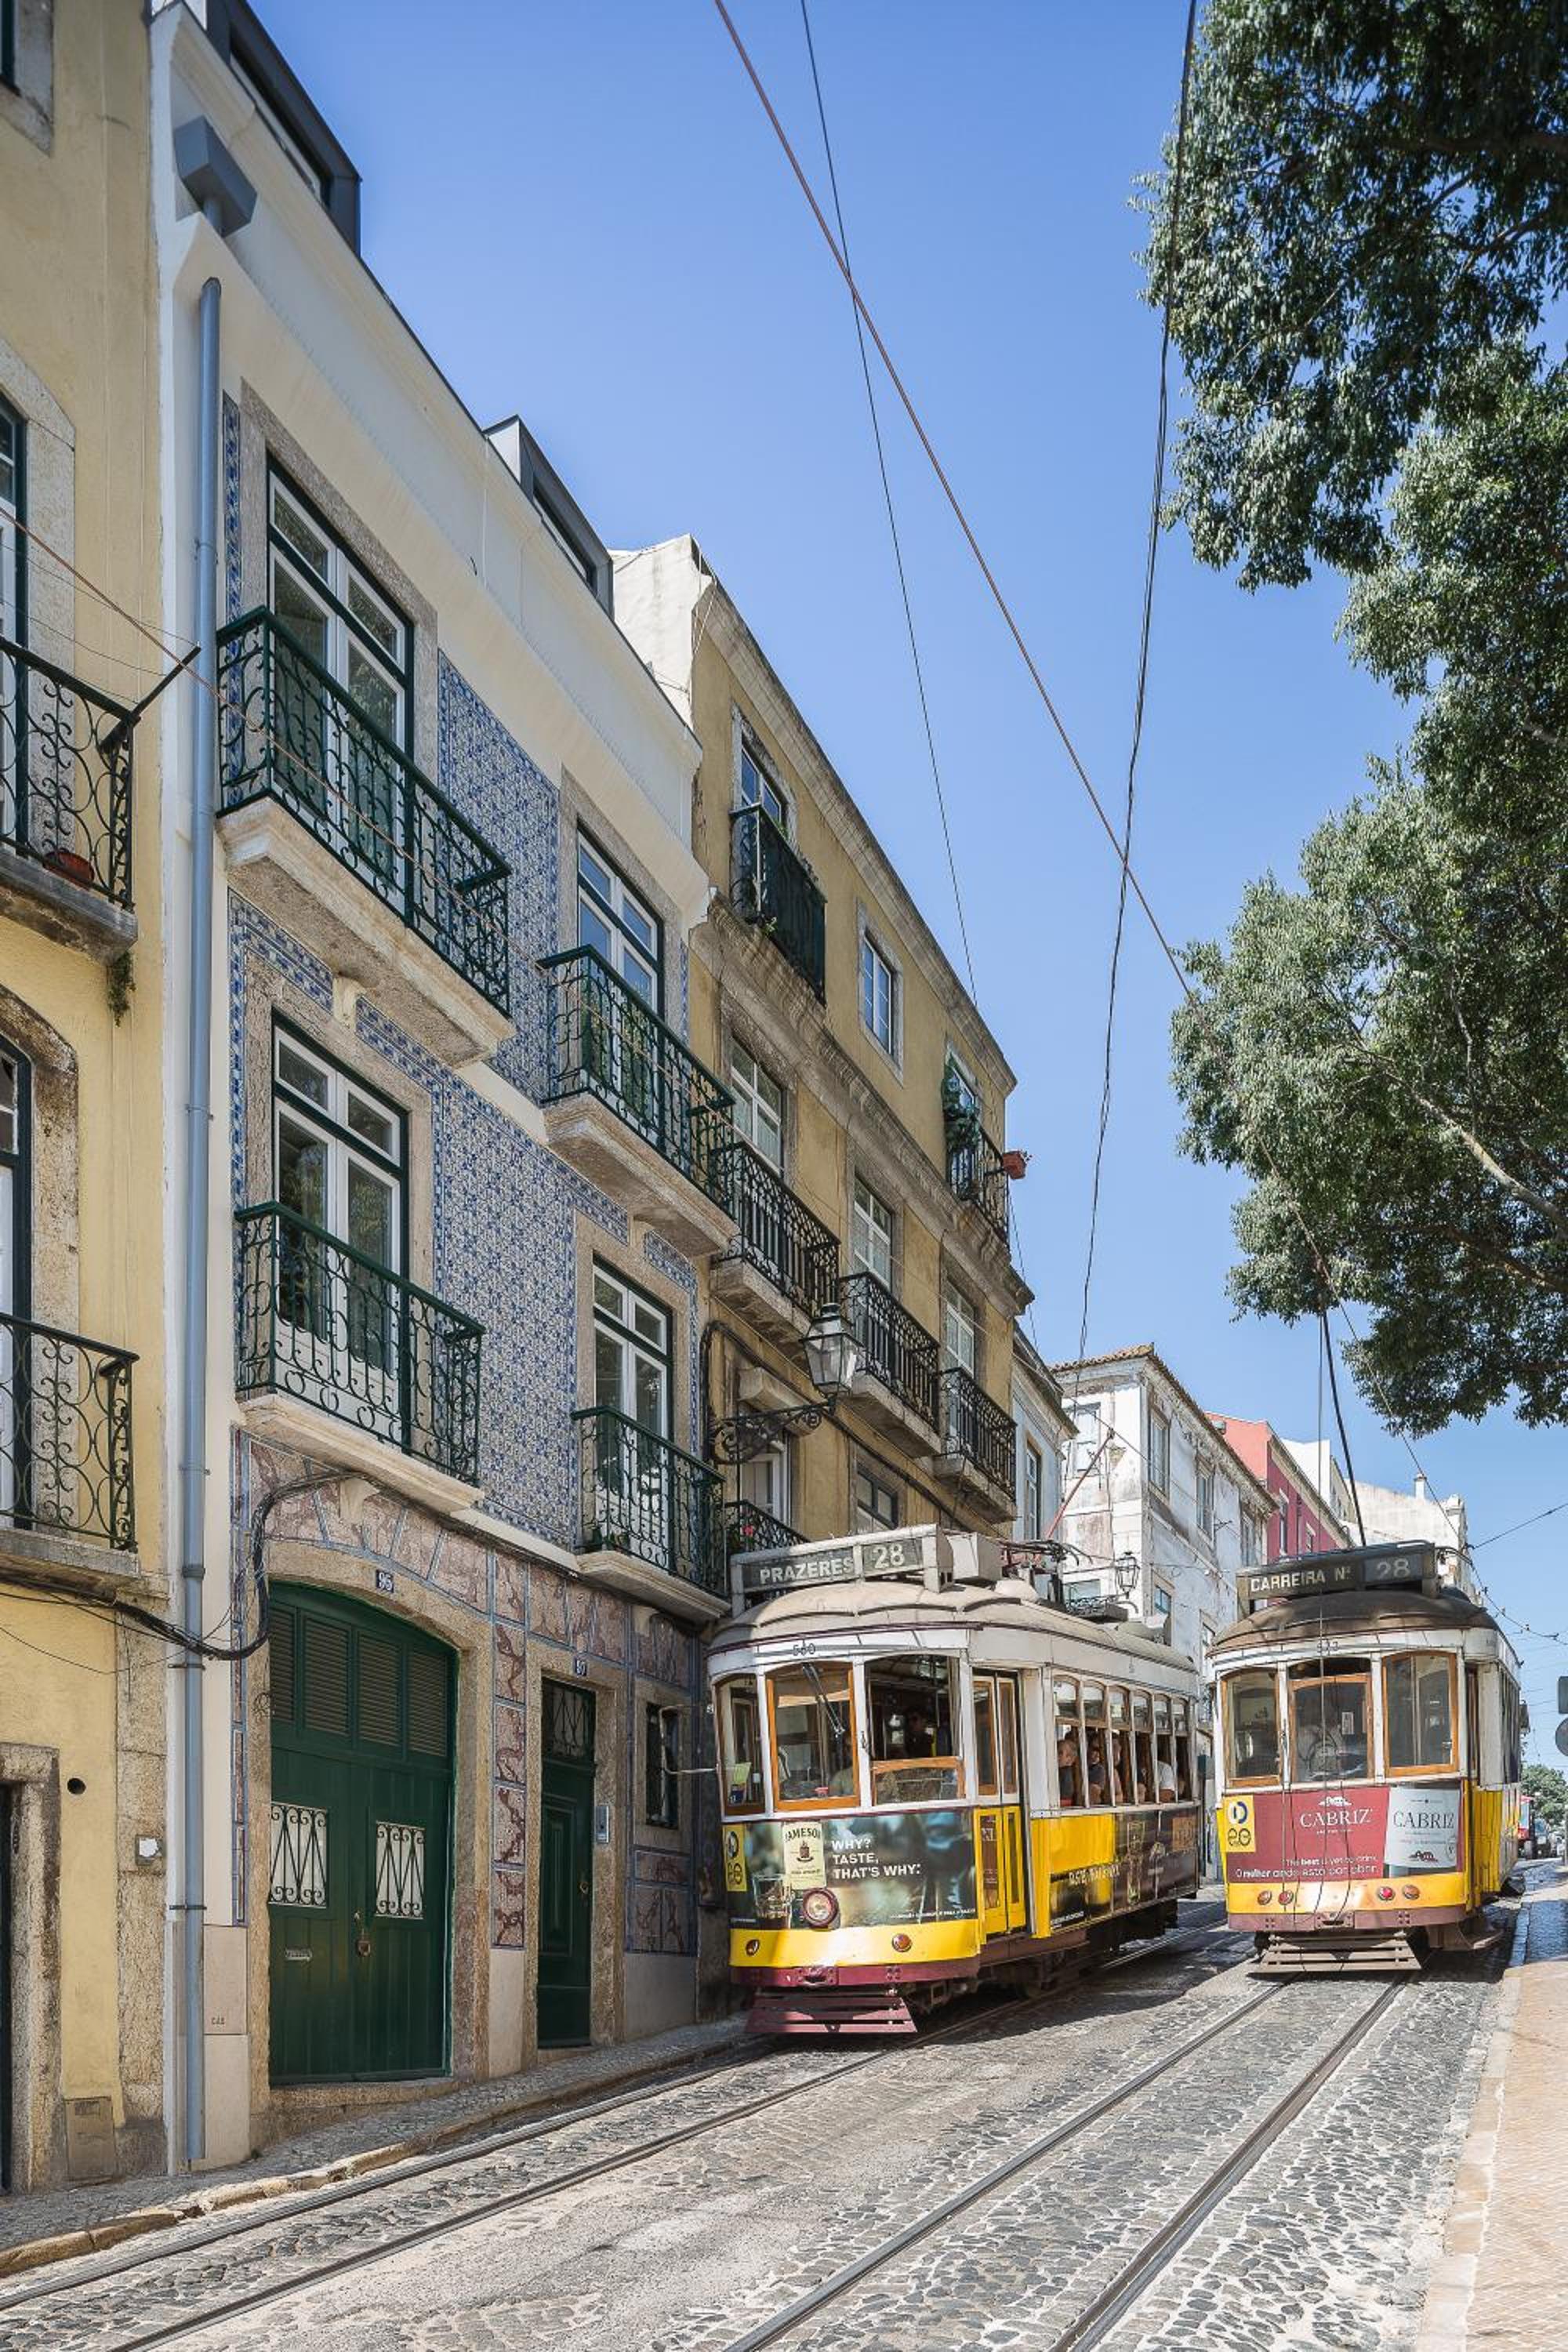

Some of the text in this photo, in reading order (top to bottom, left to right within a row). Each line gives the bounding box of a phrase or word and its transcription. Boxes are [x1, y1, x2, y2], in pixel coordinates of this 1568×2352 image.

[873, 1543, 906, 1569] 28
[759, 1557, 854, 1584] PRAZERES
[1377, 1557, 1410, 1579] 28
[1250, 1570, 1326, 1592] CARREIRA
[1300, 1808, 1372, 1828] CABRIZ
[1393, 1811, 1454, 1829] CABRIZ
[831, 1838, 871, 1851] WHY?
[833, 1853, 879, 1864] TASTE,
[833, 1867, 880, 1879] THAT'S
